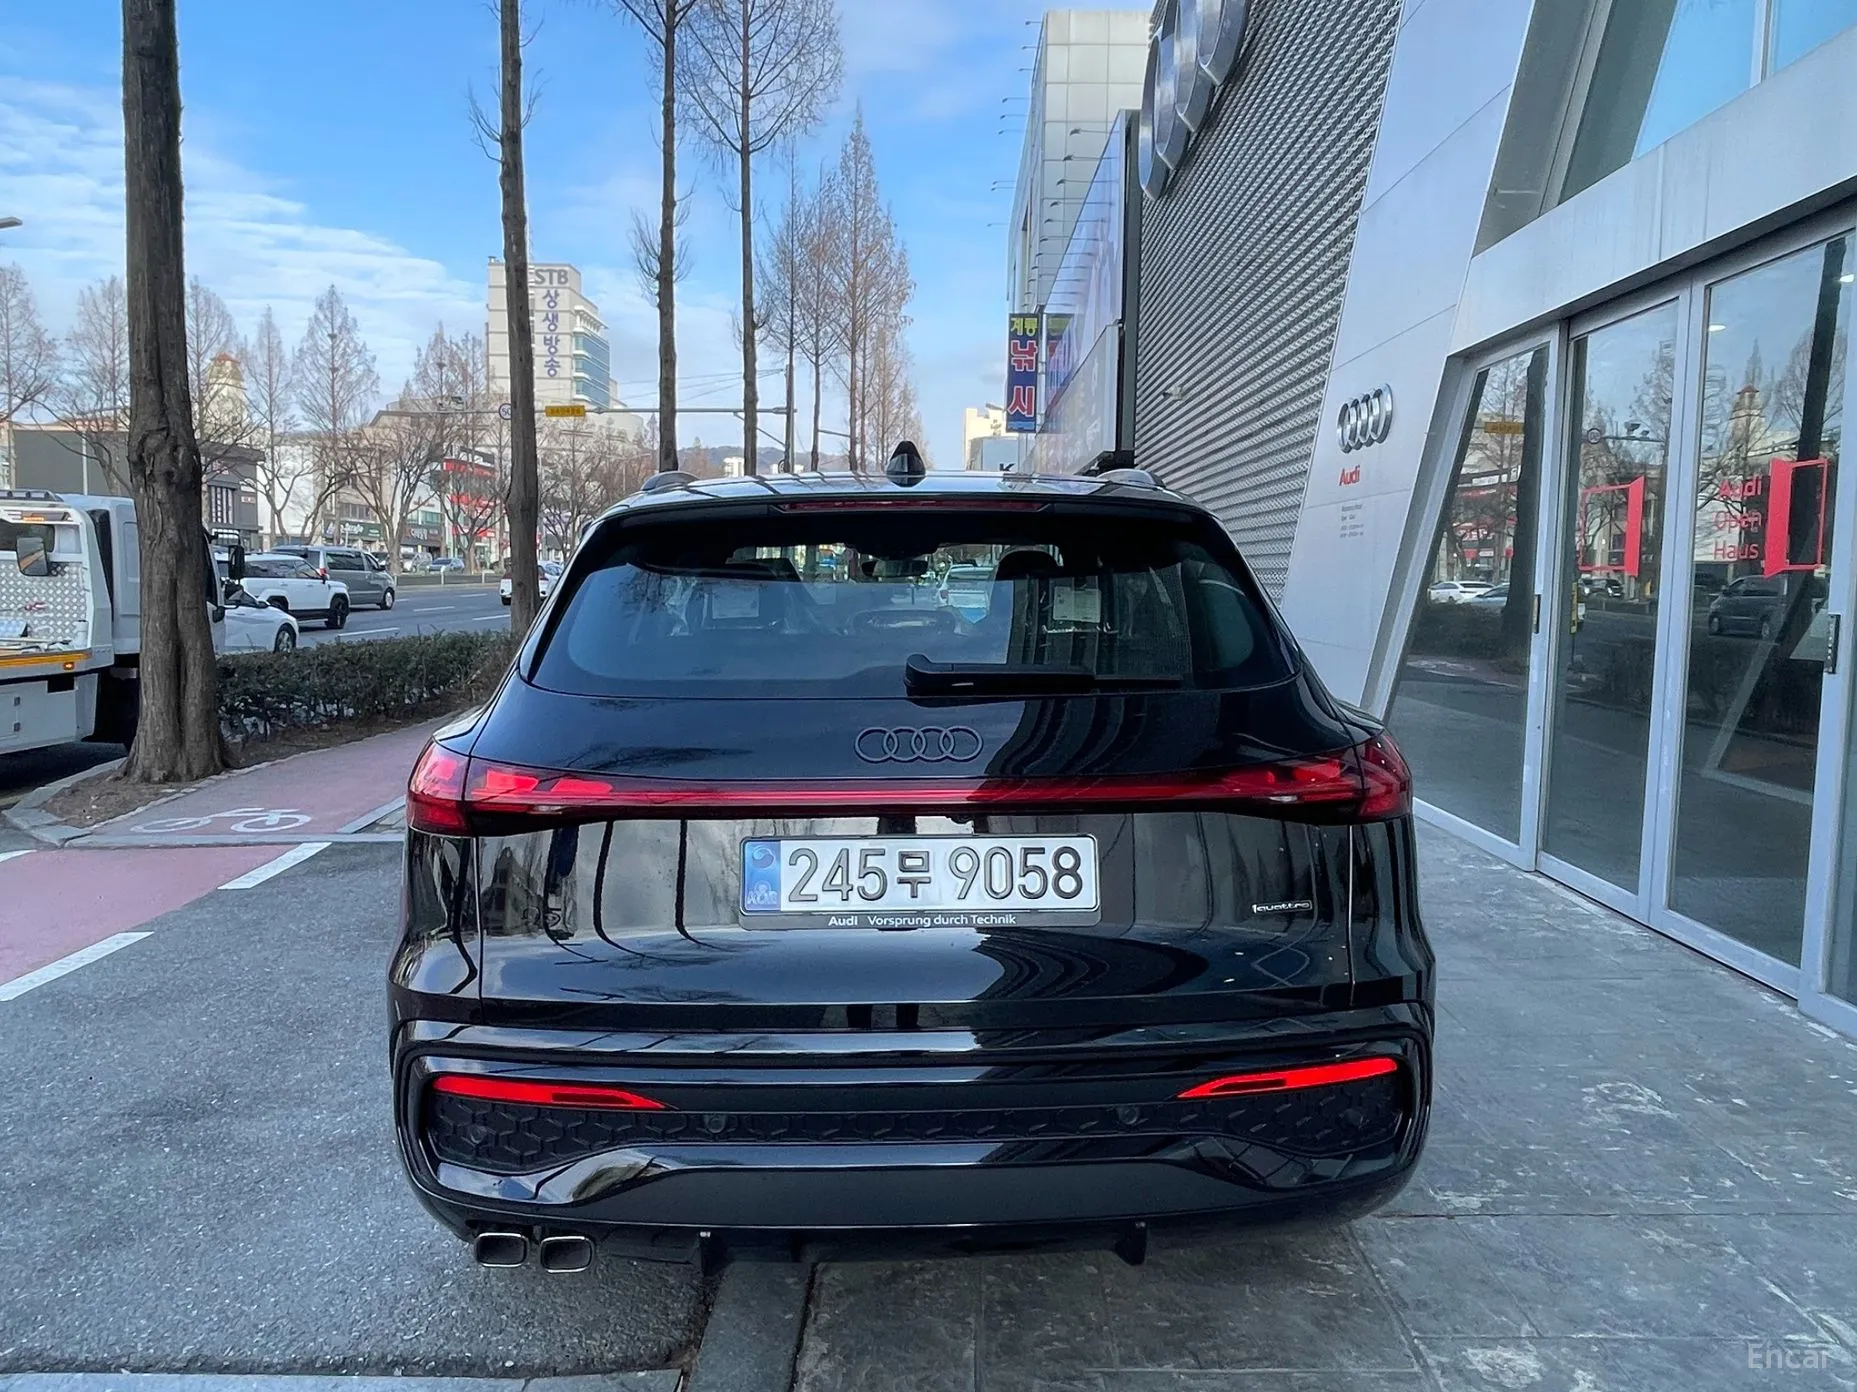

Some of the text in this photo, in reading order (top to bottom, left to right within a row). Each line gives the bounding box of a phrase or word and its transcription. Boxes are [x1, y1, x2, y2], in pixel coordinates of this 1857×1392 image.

[535, 268, 569, 285] STB
[542, 289, 561, 377] 상생방송
[1007, 340, 1038, 417] 낚시
[1339, 464, 1361, 486] Audi
[1718, 474, 1762, 499] Audi
[1714, 509, 1762, 533] Open
[1714, 541, 1760, 560] Haus
[788, 846, 1084, 903] 245무 9058
[1256, 902, 1310, 913] quattro
[828, 914, 1017, 928] Audi Vorsprung durch Technik
